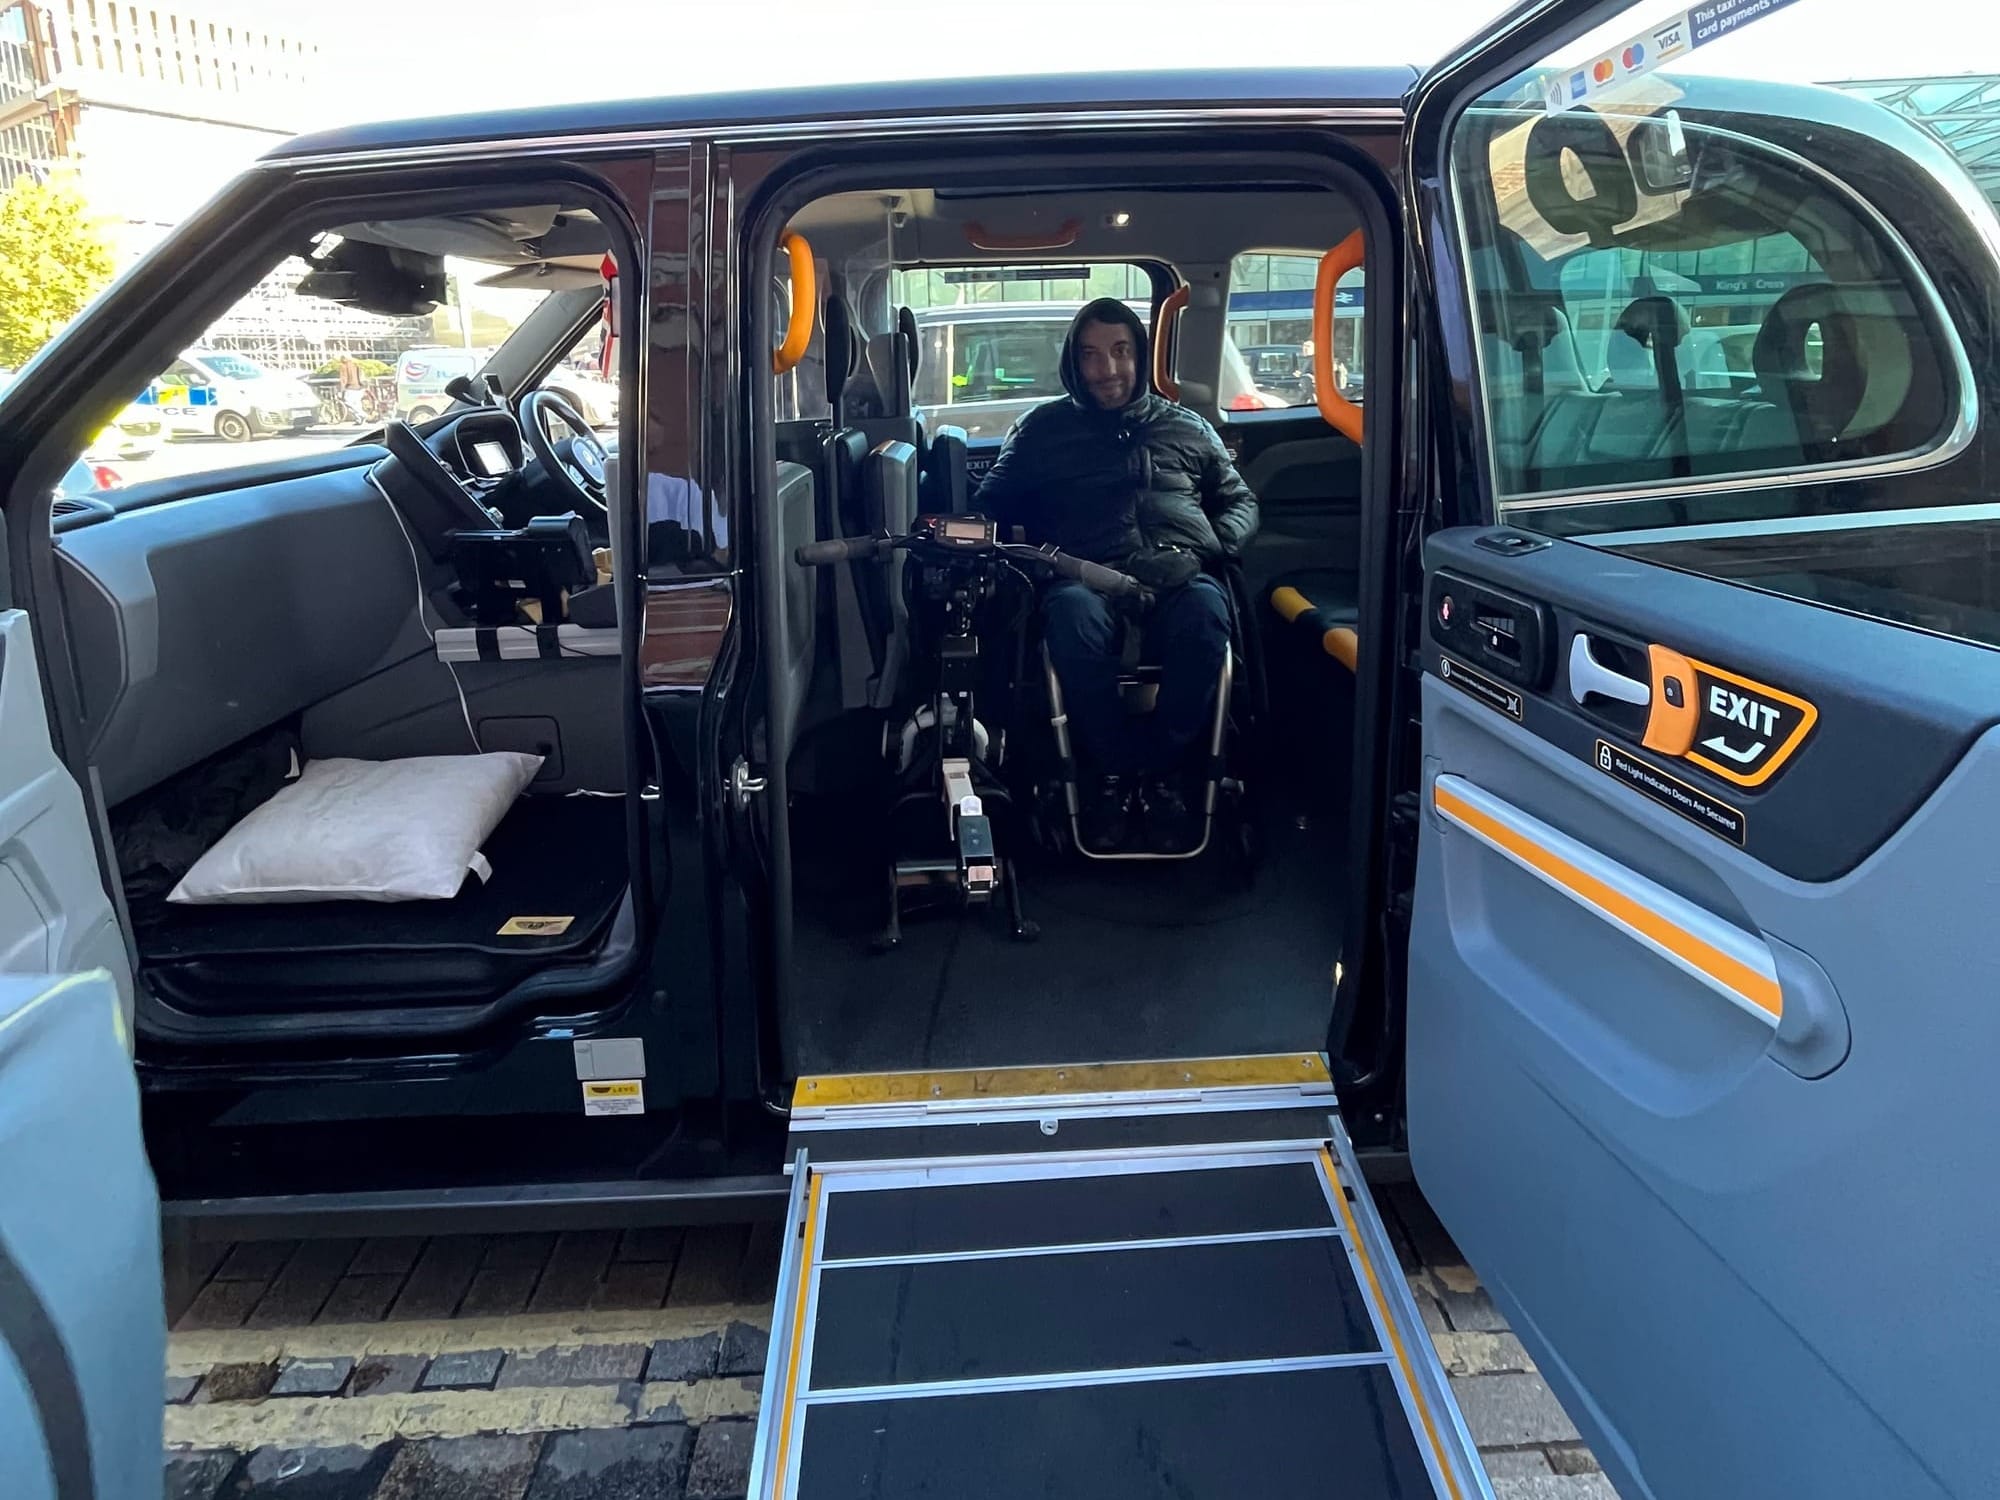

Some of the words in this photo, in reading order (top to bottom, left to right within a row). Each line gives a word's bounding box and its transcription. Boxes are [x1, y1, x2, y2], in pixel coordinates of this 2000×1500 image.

[1695, 7, 1715, 24] This
[1716, 0, 1736, 14] taxi
[1697, 20, 1718, 39] card
[1720, 0, 1770, 31] payments
[1658, 31, 1681, 49] VISA
[1716, 279, 1747, 291] King's
[1709, 685, 1780, 737] EXIT
[1615, 758, 1627, 771] Red
[1627, 764, 1643, 780] Light
[1644, 773, 1672, 796] Indicates
[1672, 788, 1693, 807] Doors
[1693, 800, 1706, 814] Are
[1706, 806, 1736, 831] Secured
